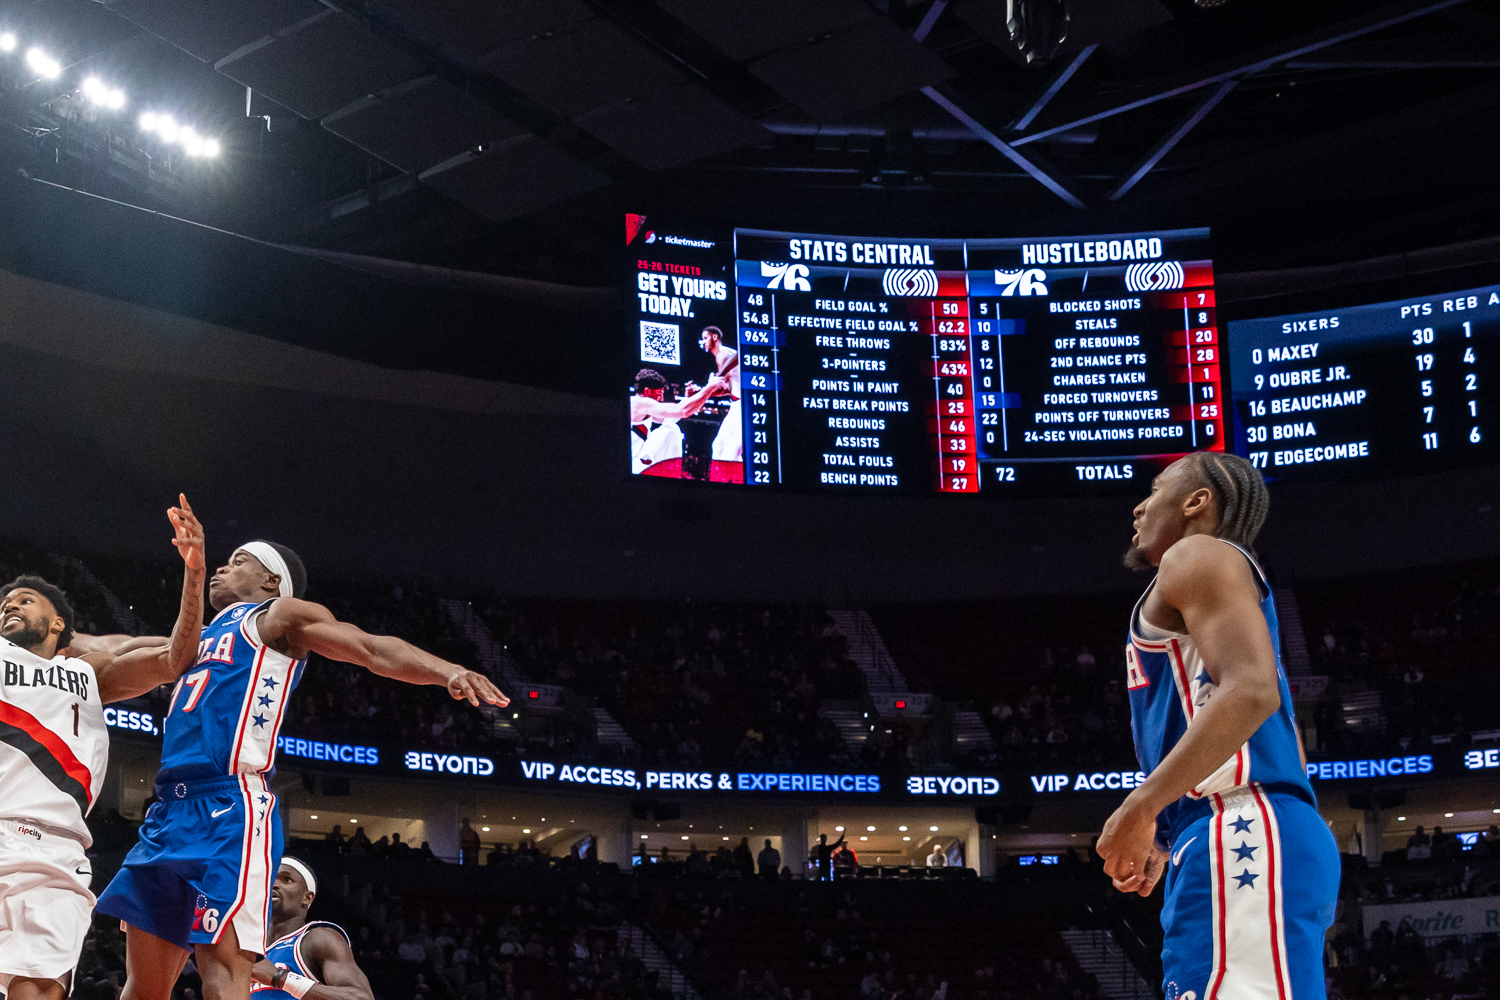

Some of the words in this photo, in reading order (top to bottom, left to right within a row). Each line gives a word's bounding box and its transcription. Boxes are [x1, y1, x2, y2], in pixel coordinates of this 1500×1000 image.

[665, 236, 715, 248] ticketmaster
[790, 239, 847, 262] STATS
[852, 243, 934, 265] CENTRAL
[1022, 238, 1162, 265] HUSTLEBOARD
[665, 262, 701, 276] TICKETS
[638, 272, 668, 293] GET
[671, 276, 726, 302] YOURS
[638, 291, 696, 317] TODAY.
[748, 294, 763, 306] 48
[816, 299, 845, 311] FIELD
[848, 301, 876, 312] GOAL
[879, 303, 888, 312] %
[943, 303, 958, 314] 50
[980, 303, 987, 314] 5
[1050, 301, 1101, 312] BLOCKED
[1104, 299, 1140, 310] SHOTS
[1198, 294, 1205, 305] 7
[743, 312, 769, 325] 54.8
[788, 316, 842, 329] EFFECTIVE
[845, 319, 875, 330] FIELD
[878, 321, 906, 331] GOAL
[909, 322, 918, 331] %
[939, 322, 964, 333] 62.2
[977, 322, 990, 332] 10
[1076, 318, 1117, 330] STEALS
[1199, 312, 1207, 323] 8
[1282, 317, 1339, 334] SIXERS
[1401, 303, 1432, 319] PTS
[1443, 296, 1477, 312] REB
[745, 331, 768, 343] 96%
[816, 336, 843, 347] FREE
[846, 338, 890, 349] THROWS
[940, 340, 966, 351] 83%
[982, 340, 989, 351] 8
[1055, 338, 1076, 349] OFF
[1080, 336, 1139, 348] REBOUNDS
[1196, 330, 1212, 342] 20
[1253, 349, 1262, 364] 0
[1268, 343, 1319, 362] MAXEY
[1413, 328, 1433, 345] 30
[1463, 321, 1471, 337] 1
[744, 354, 769, 367] 38%
[822, 358, 886, 371] 3-POINTERS
[941, 364, 967, 375] 43%
[980, 358, 993, 369] 12
[1051, 357, 1073, 367] 2ND
[1077, 355, 1122, 366] CHANCE
[1126, 354, 1146, 364] PTS
[1197, 349, 1214, 361] 28
[1254, 374, 1264, 390] 9
[1270, 369, 1321, 388] OUBRE
[1326, 366, 1350, 381] JR.
[1416, 354, 1433, 370] 19
[1464, 348, 1475, 363] 4
[751, 376, 765, 387] 42
[813, 380, 849, 391] POINTS
[853, 382, 864, 392] IN
[868, 382, 898, 393] PAINT
[947, 384, 963, 395] 40
[1054, 374, 1105, 386] CHARGES
[1109, 372, 1145, 384] TAKEN
[1204, 368, 1209, 379] 1
[752, 394, 765, 406] 14
[803, 398, 829, 408] FAST
[833, 399, 868, 411] BREAK
[871, 401, 908, 412] POINTS
[949, 402, 964, 413] 25
[982, 395, 995, 406] 15
[1044, 393, 1088, 404] FORCED
[1091, 390, 1158, 403] TURNOVERS
[1202, 386, 1213, 398] 11
[1249, 400, 1266, 416] 16
[1271, 390, 1366, 414] BEAUCHAMP
[1422, 380, 1432, 396] 5
[1466, 374, 1477, 390] 2
[753, 413, 766, 424] 27
[829, 417, 885, 429] REBOUNDS
[950, 421, 965, 432] 46
[982, 413, 997, 424] 22
[1035, 412, 1074, 423] POINTS
[1078, 411, 1099, 422] OFF
[1102, 408, 1169, 421] TURNOVERS
[1201, 405, 1217, 417] 25
[1247, 426, 1267, 443] 30
[1273, 422, 1316, 440] BONA
[1424, 407, 1433, 423] 7
[1469, 401, 1476, 416] 1
[754, 431, 766, 443] 21
[836, 436, 879, 448] ASSISTS
[951, 439, 966, 450] 33
[1025, 431, 1065, 442] 24-SEC
[1069, 429, 1134, 440] VIOLATIONS
[1138, 426, 1183, 438] FORCED
[1250, 452, 1268, 469] 77
[1274, 442, 1368, 465] EDGECOMBE
[1423, 433, 1437, 449] 11
[1470, 427, 1480, 443] 6
[754, 452, 768, 464] 20
[823, 454, 855, 465] TOTAL
[859, 456, 893, 467] FOULS
[952, 460, 965, 470] 19
[755, 471, 769, 483] 22
[821, 473, 856, 484] BENCH
[860, 474, 898, 485] POINTS
[952, 478, 967, 489] 27
[996, 467, 1015, 481] 72
[1076, 465, 1132, 480] TOTALS
[3, 659, 90, 702] BLAZERS
[71, 702, 80, 738] 1
[102, 708, 158, 736] CESS,
[278, 737, 378, 764] PERIENCES
[521, 761, 555, 779] VIP
[559, 765, 641, 790] ACCESS,
[646, 772, 712, 789] PERKS
[718, 773, 732, 789] &
[738, 774, 880, 792] EXPERIENCES
[1304, 756, 1432, 782] PERIENCES
[1031, 775, 1068, 792] VIP
[1074, 771, 1148, 793] ACCES
